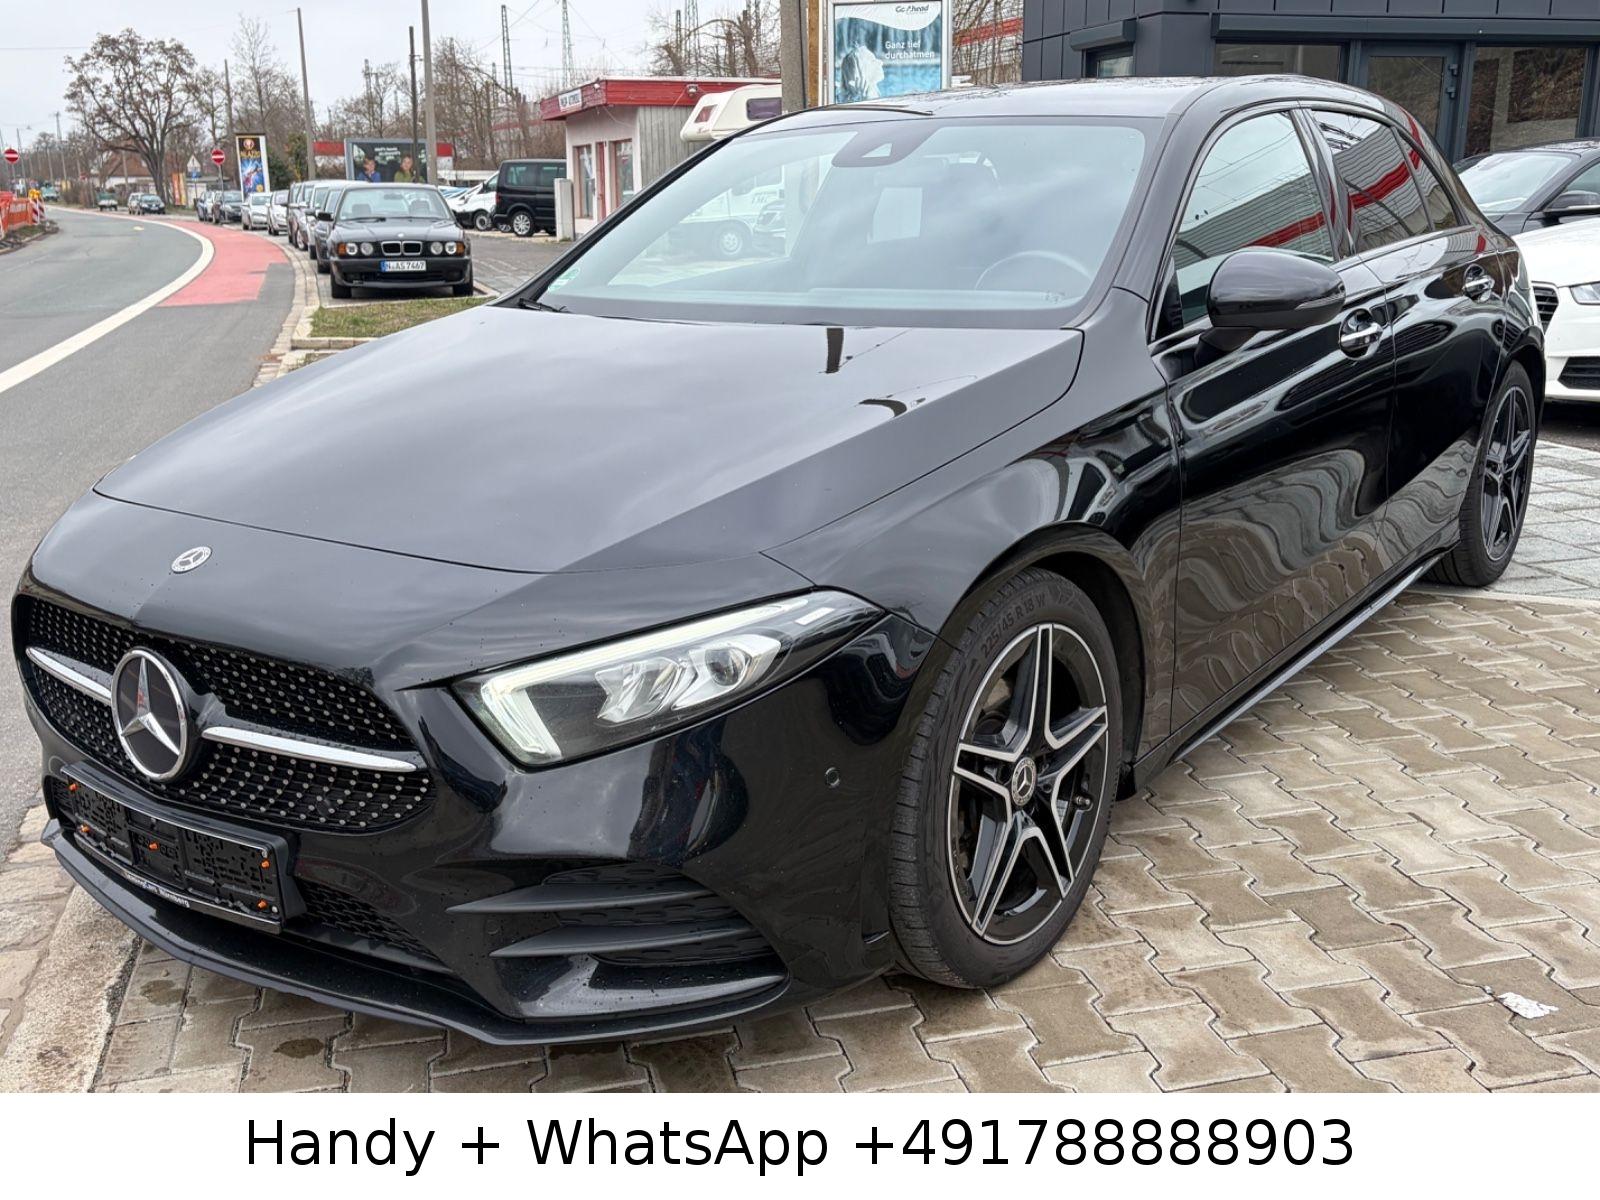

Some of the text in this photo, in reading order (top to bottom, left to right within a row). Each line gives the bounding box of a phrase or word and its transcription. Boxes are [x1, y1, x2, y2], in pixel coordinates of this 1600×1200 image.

[885, 39, 921, 49] Ganz tief
[884, 50, 935, 59] durchatmen
[1024, 598, 1035, 614] 18
